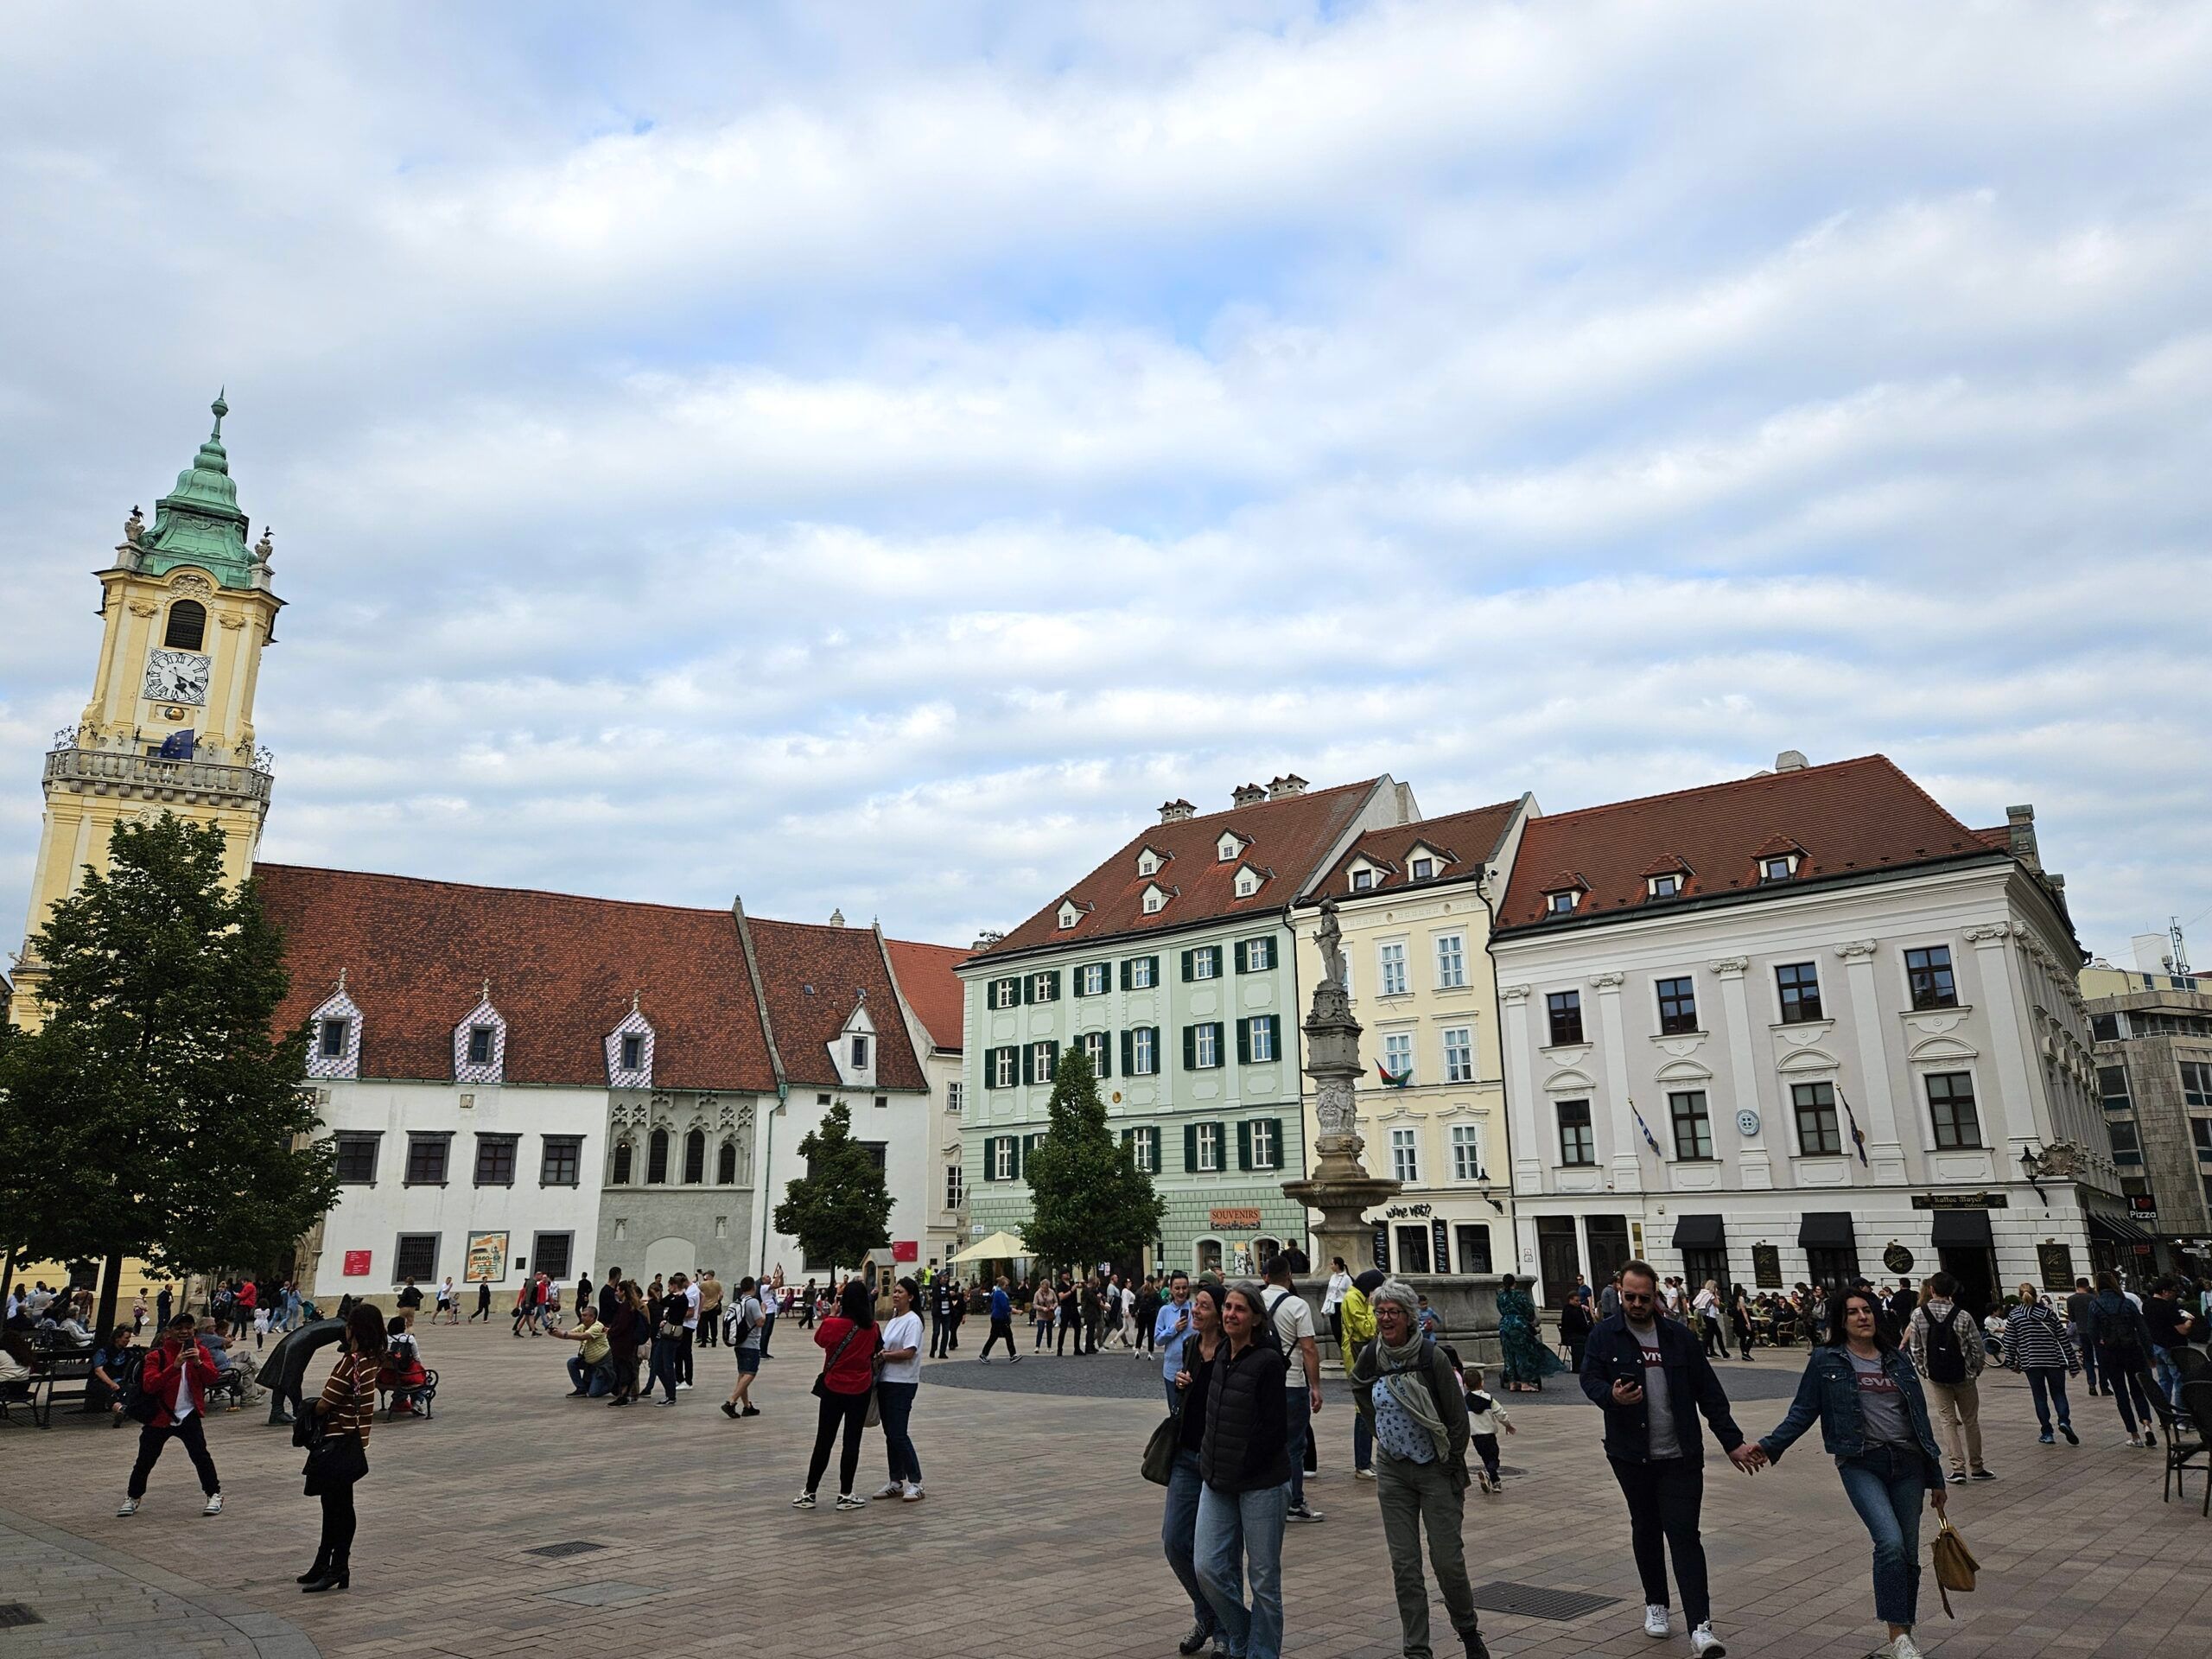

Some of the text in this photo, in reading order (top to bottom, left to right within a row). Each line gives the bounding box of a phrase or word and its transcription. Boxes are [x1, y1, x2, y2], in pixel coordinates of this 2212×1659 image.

[163, 656, 174, 665] XI
[2131, 1197, 2136, 1210] I
[1211, 1210, 1259, 1219] SOUVENIRS
[1386, 1205, 1408, 1218] wine
[2129, 1210, 2157, 1218] Pizza
